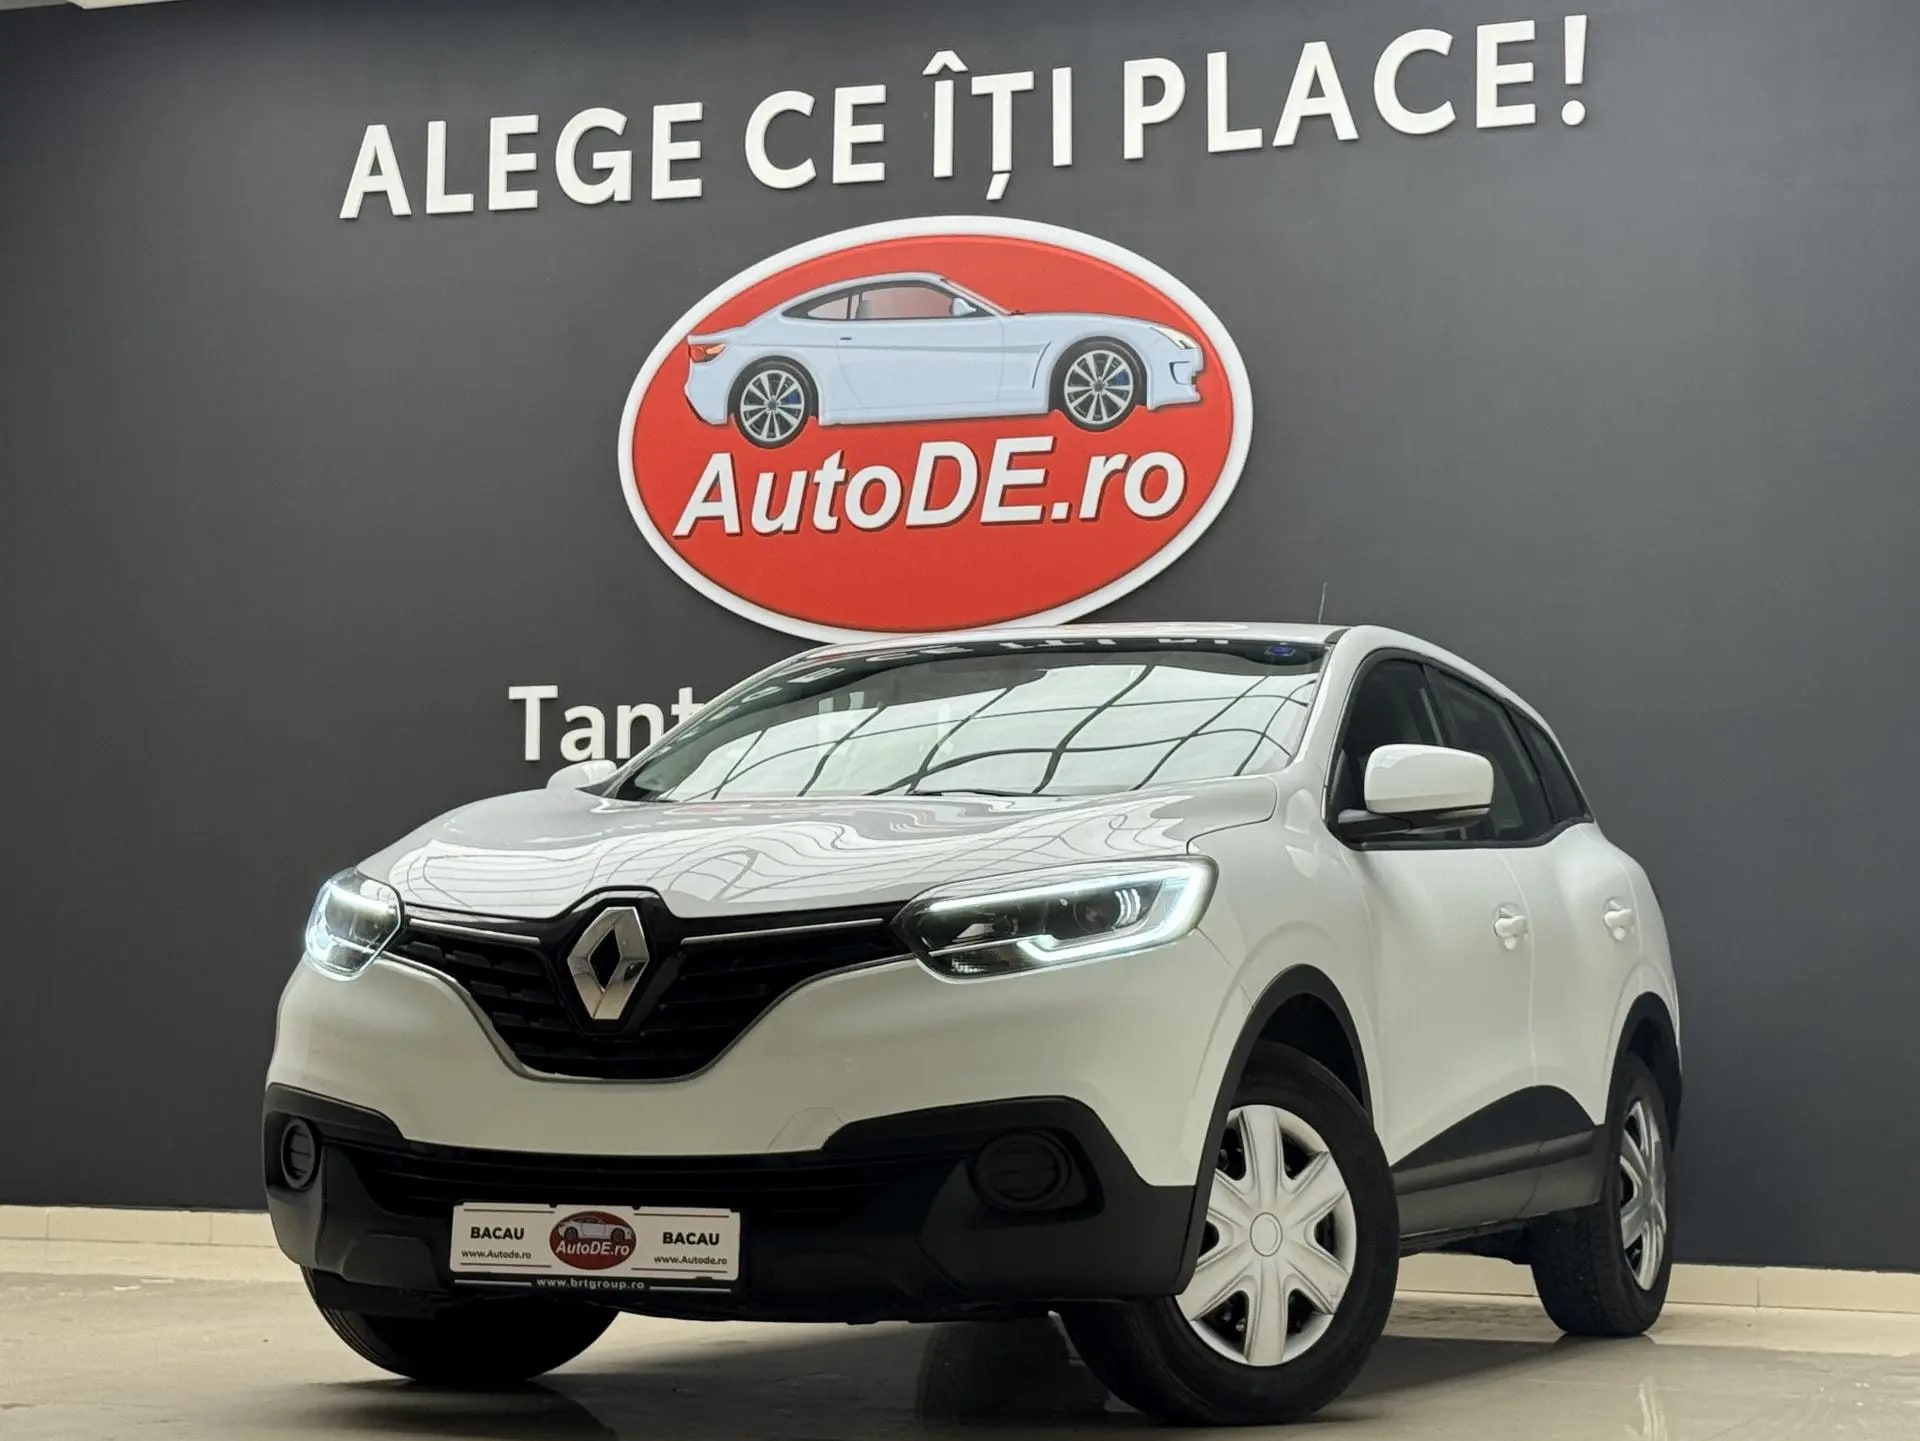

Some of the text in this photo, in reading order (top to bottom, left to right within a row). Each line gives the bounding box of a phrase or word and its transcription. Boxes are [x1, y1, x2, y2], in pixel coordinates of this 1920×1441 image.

[339, 102, 703, 219] ALEGE
[744, 84, 886, 190] CE
[1123, 14, 1589, 160] PLACE!
[672, 435, 1188, 539] AutoDE.ro
[470, 1226, 525, 1240] BACAU
[662, 1231, 720, 1246] BACAU
[460, 1249, 532, 1259] www.Autode.ro
[555, 1240, 630, 1256] AutoDE.ro
[653, 1255, 728, 1265] www.Autode.ro
